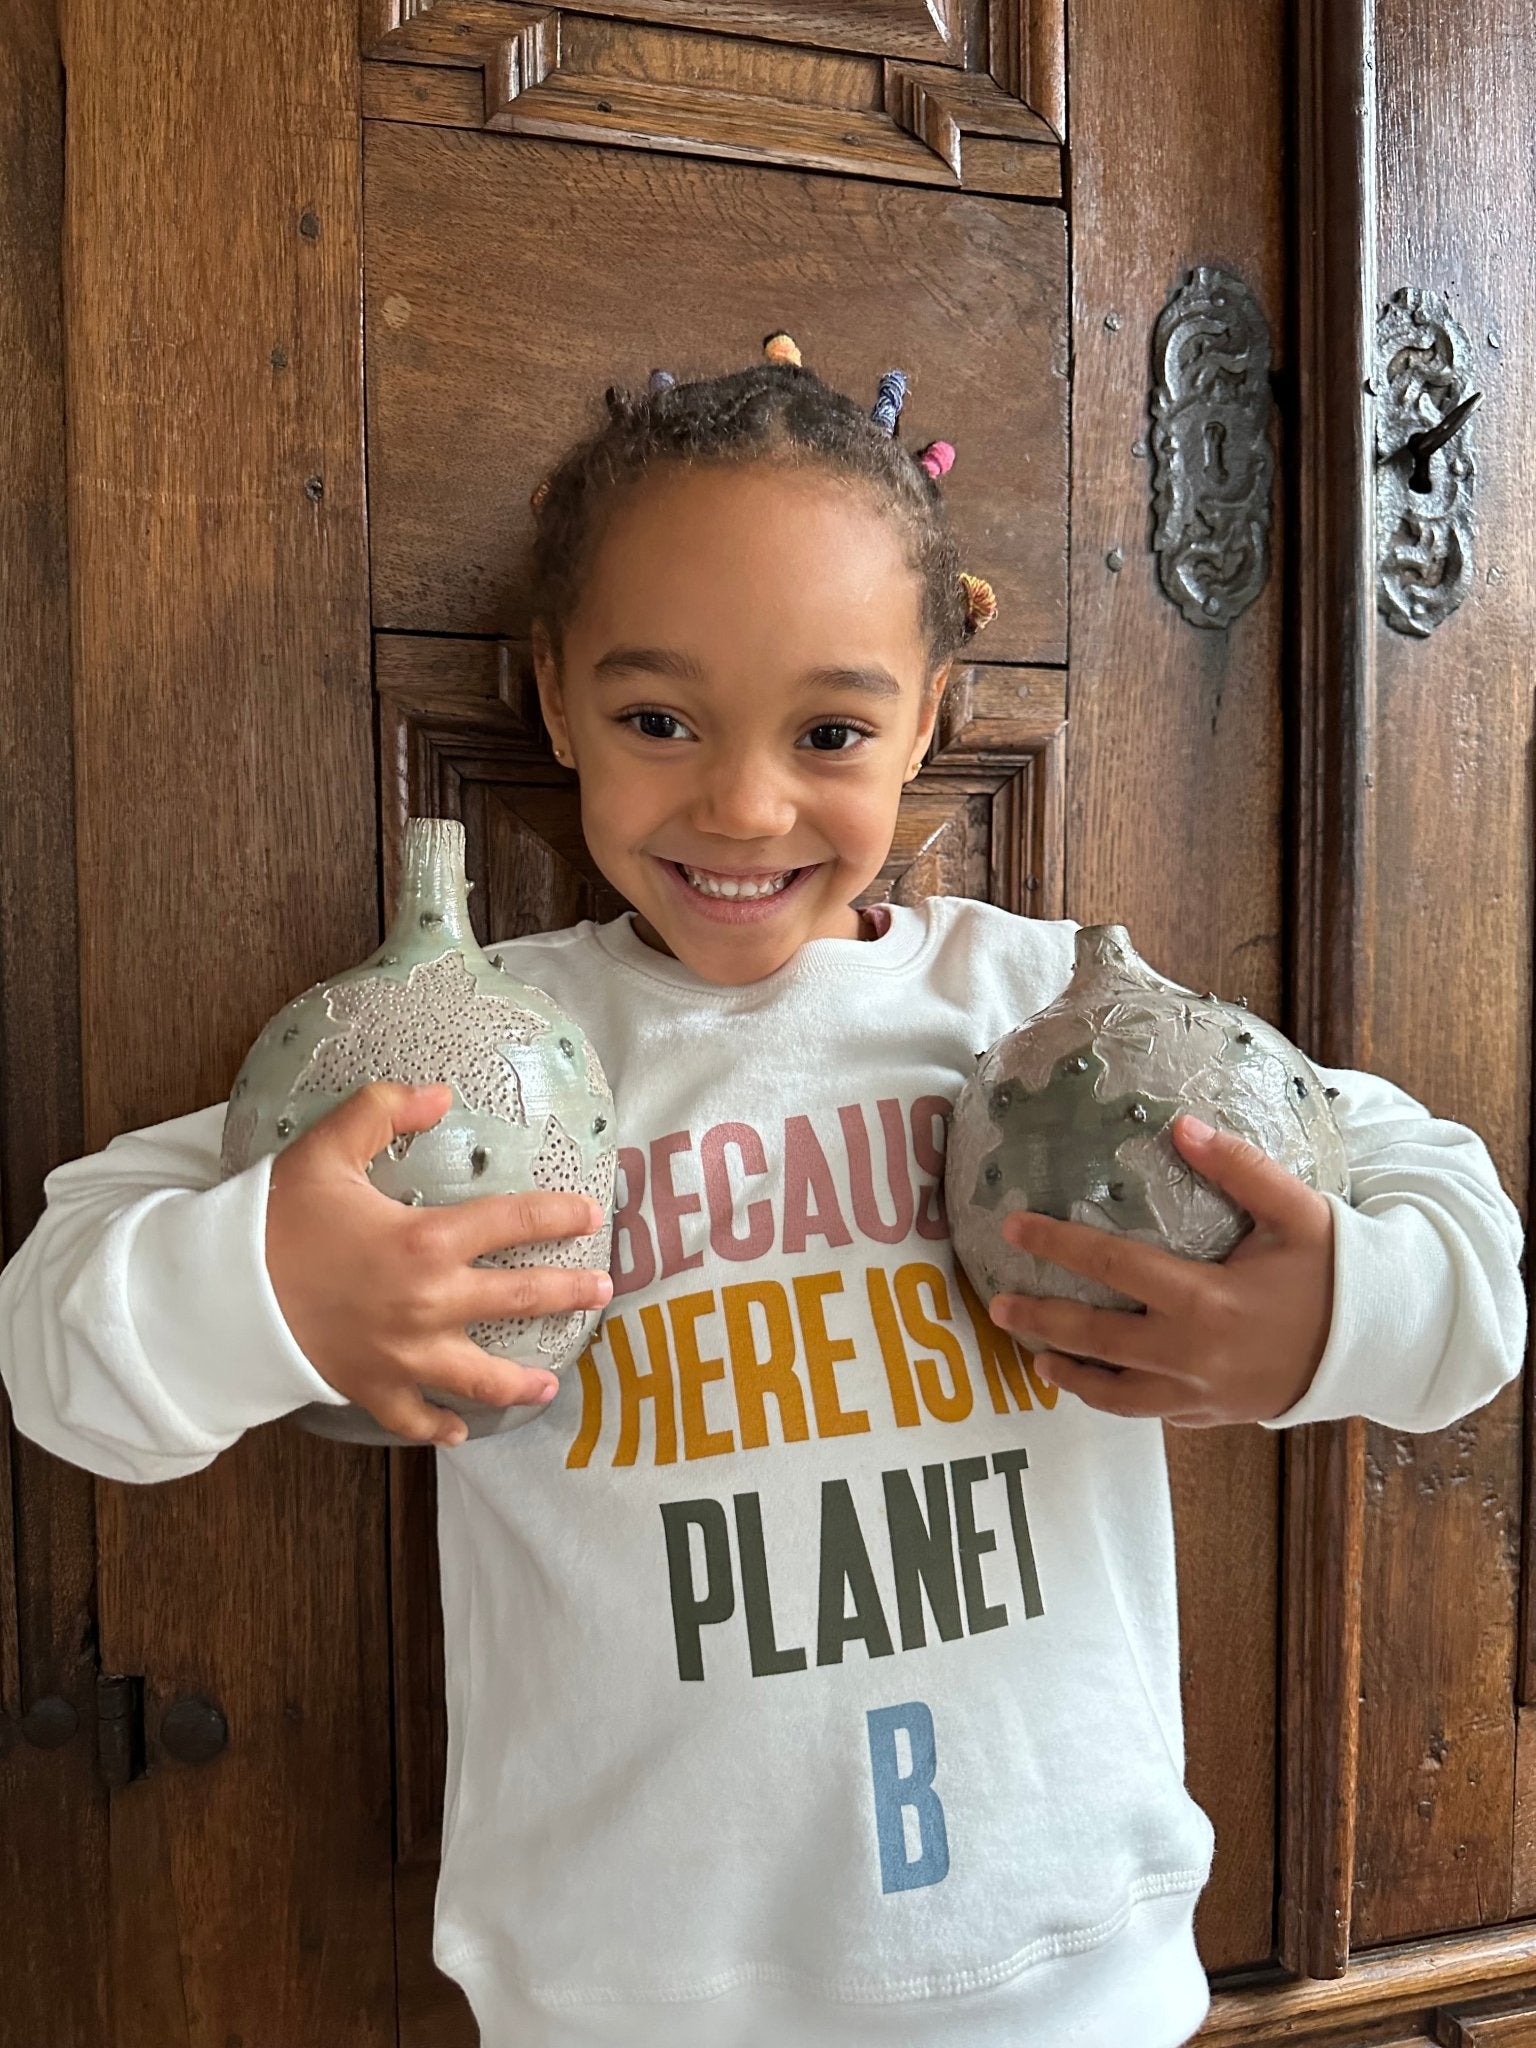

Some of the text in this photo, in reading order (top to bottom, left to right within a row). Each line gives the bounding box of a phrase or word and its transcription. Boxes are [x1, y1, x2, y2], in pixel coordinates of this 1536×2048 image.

[609, 1095, 954, 1297] BECAUS
[566, 1271, 871, 1470] THERE
[866, 1262, 974, 1423] IS
[659, 1448, 1045, 1681] PLANET
[866, 1701, 950, 1895] B
